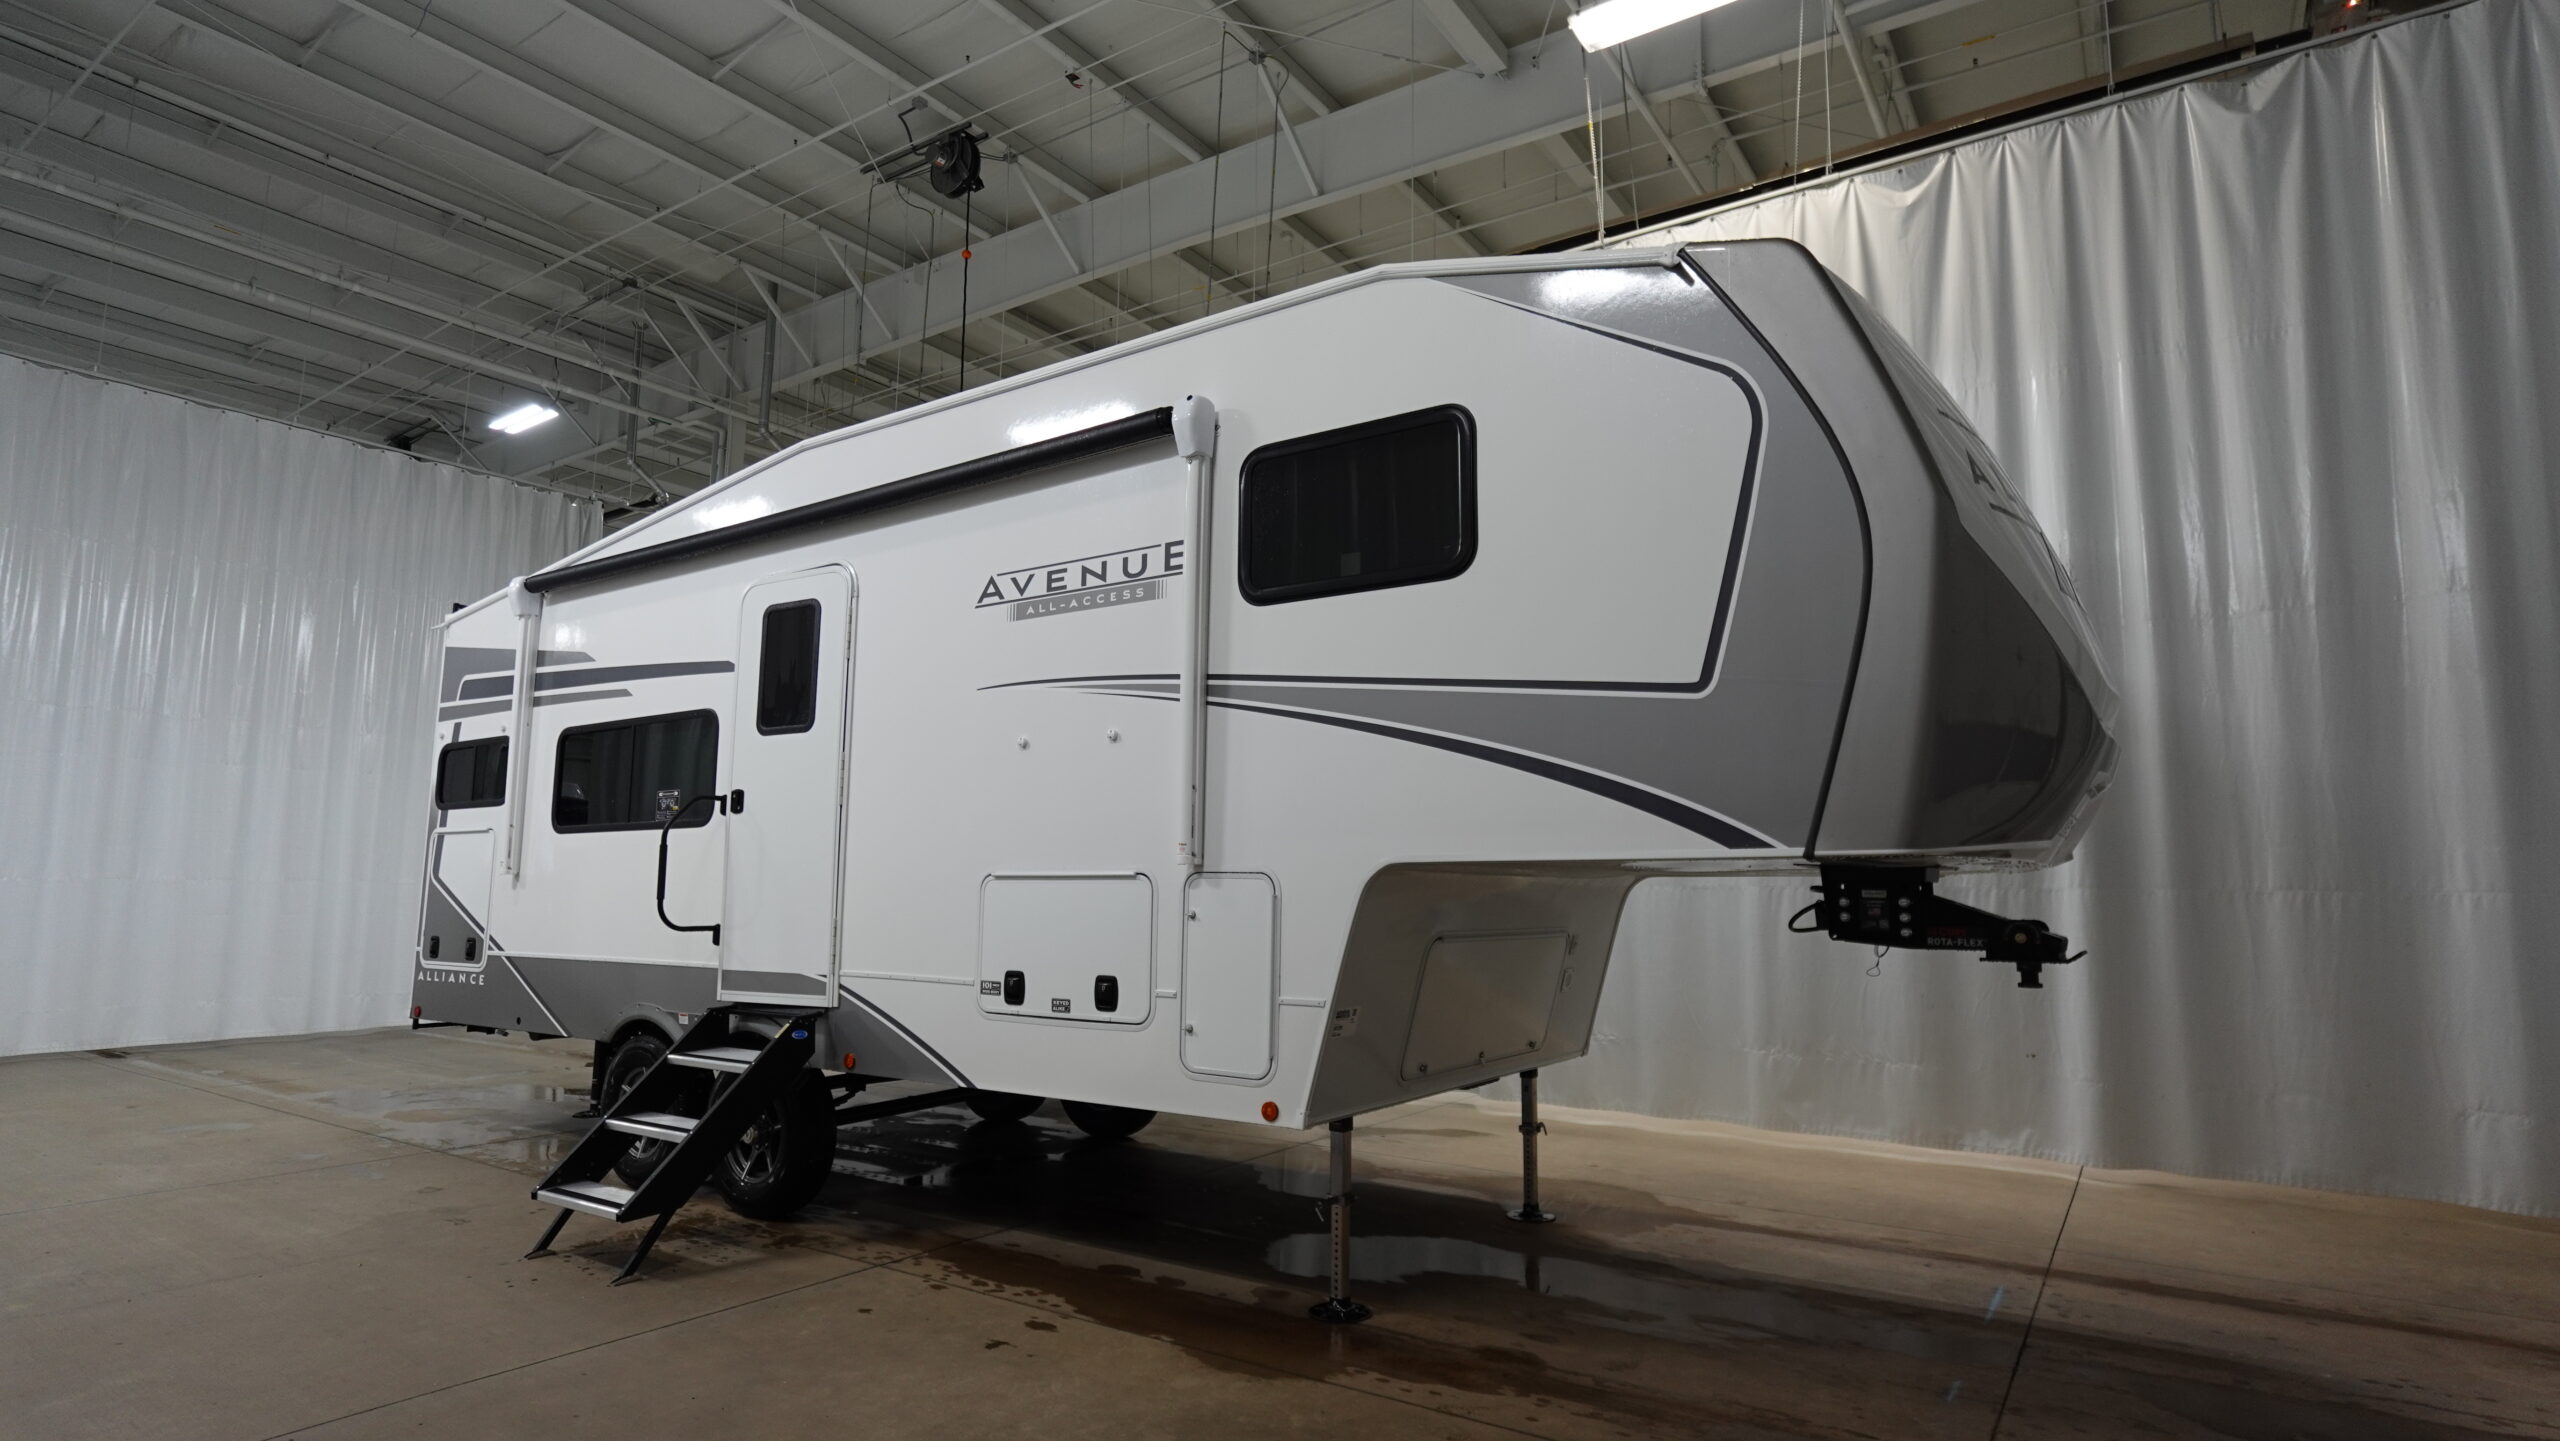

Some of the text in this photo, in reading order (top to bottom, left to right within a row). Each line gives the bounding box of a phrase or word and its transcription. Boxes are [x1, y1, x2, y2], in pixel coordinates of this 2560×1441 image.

[977, 539, 1184, 604] AVENUE
[1026, 587, 1144, 615] ALL-ACCESS
[1927, 937, 1984, 948] ROTA-FLEX
[417, 970, 485, 986] ALLIANCE
